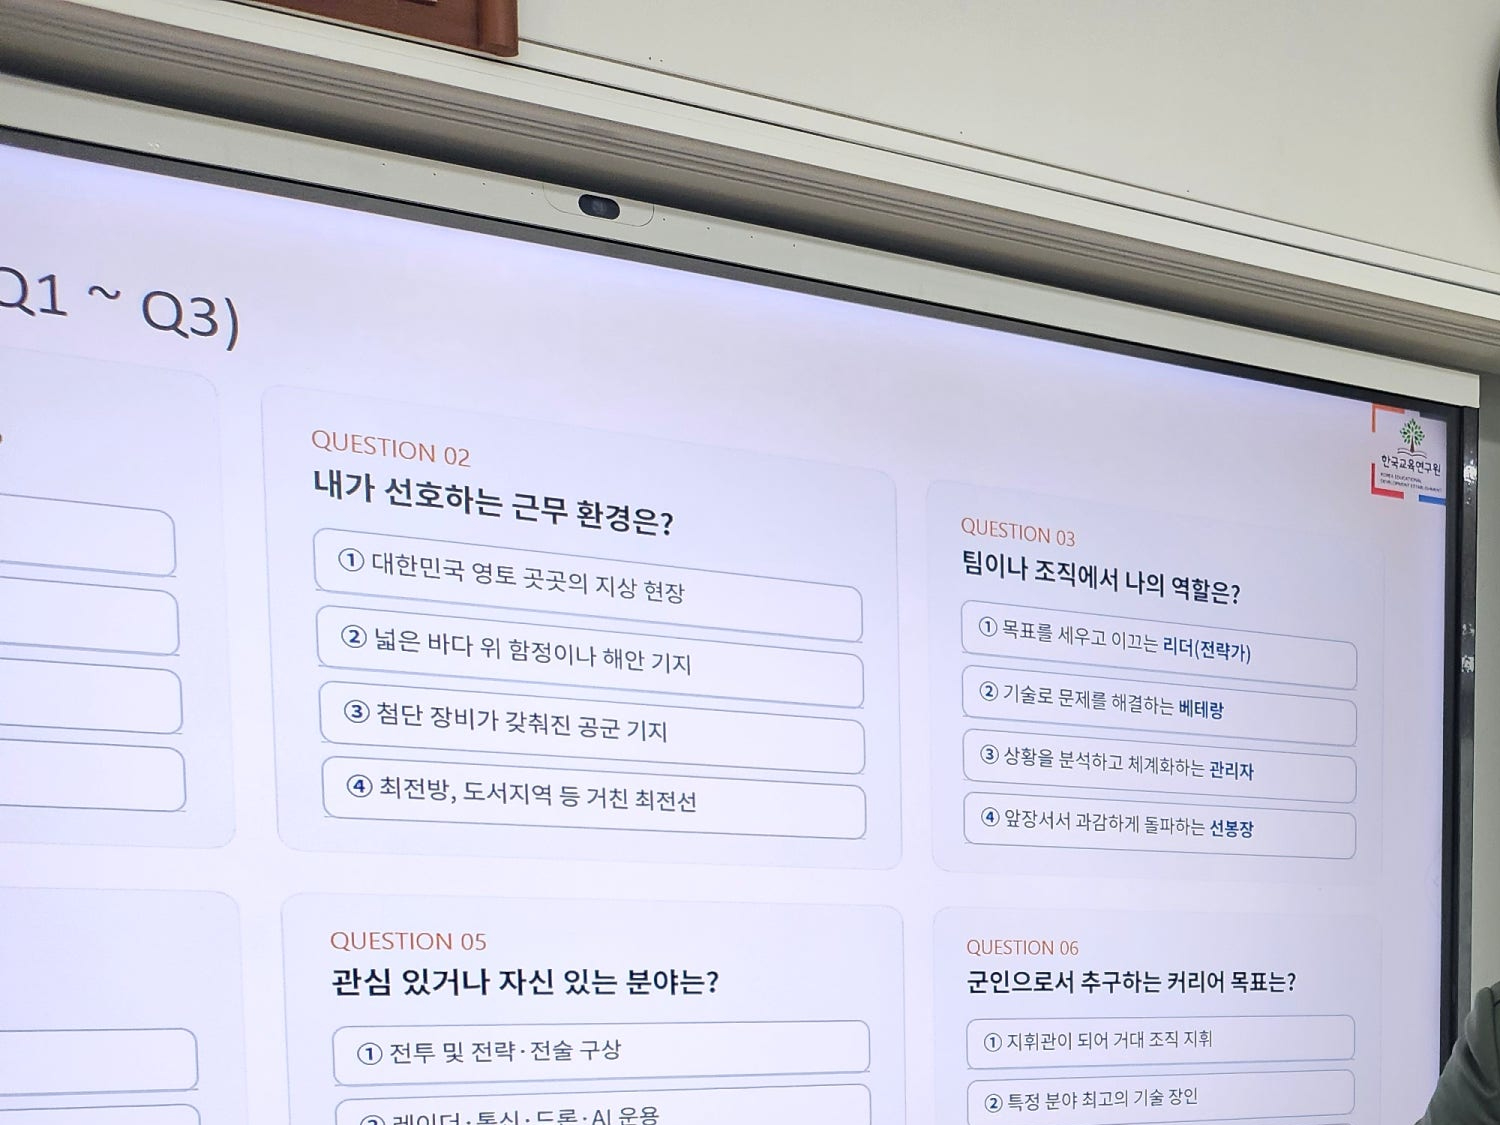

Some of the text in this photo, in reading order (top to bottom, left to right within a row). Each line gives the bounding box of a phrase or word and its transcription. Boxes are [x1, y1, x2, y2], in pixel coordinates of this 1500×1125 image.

[142, 290, 239, 351] Q3)
[311, 429, 472, 468] QUESTION 02
[1381, 454, 1441, 477] 한국교육연구원
[313, 469, 674, 537] 내가 선호하는 근무 환경은?
[960, 517, 1076, 548] QUESTION 03
[372, 552, 465, 583] 대한민국
[471, 562, 517, 586] 영토
[522, 567, 588, 596] 곳곳의
[595, 575, 638, 600] 지상
[643, 579, 686, 605] 현장
[963, 549, 1241, 605] 팀이나 조직에서 나의 역할은?
[375, 627, 421, 654] 넓은
[428, 632, 474, 658] 바다
[479, 637, 501, 660] 위
[508, 638, 597, 668] 함정이나
[602, 647, 646, 672] 해안
[651, 652, 691, 677] 기지
[1002, 619, 1053, 643] 목표를
[1057, 625, 1107, 647] 세우고
[1111, 631, 1159, 654] 이끄는
[1163, 636, 1251, 665] 리더(전략가)
[1003, 683, 1054, 705] 기술로
[1057, 688, 1107, 711] 문제를
[1111, 693, 1175, 716] 해결하는
[1178, 698, 1225, 720] 베테랑
[376, 701, 424, 727] 첨단
[430, 705, 500, 732] 장비가
[505, 710, 571, 737] 갖춰진
[577, 716, 621, 740] 공군
[627, 719, 667, 744] 기지
[1003, 746, 1054, 768] 상황을
[1058, 750, 1124, 772] 분석하고
[1127, 755, 1206, 778] 체계화하는
[1209, 760, 1255, 782] 관리자
[379, 775, 457, 805] 최전방,
[462, 781, 552, 807] 도서지역
[559, 785, 581, 808] 등
[586, 786, 629, 810] 거친
[635, 788, 697, 813] 최전선
[1004, 808, 1071, 831] 앞장서서
[1075, 812, 1140, 834] 과감하게
[1144, 816, 1206, 837] 돌파하는
[1209, 819, 1255, 839] 선봉장
[330, 931, 487, 952] QUESTION 05
[966, 938, 1079, 957] QUESTION 06
[331, 967, 719, 997] 관심 있거나 자신 있는 분야는?
[966, 969, 1297, 995] 군인으로서 추구하는 커리어 목표는?
[389, 1042, 437, 1065] 전투
[442, 1041, 464, 1064] 및
[579, 1038, 622, 1061] 구상
[1006, 1031, 1072, 1052] 지휘관이
[1077, 1031, 1109, 1051] 되어
[1113, 1030, 1144, 1050] 거대
[1148, 1029, 1179, 1049] 조직
[1183, 1029, 1212, 1049] 지휘
[1007, 1092, 1040, 1113] 특정
[1044, 1091, 1078, 1111] 분야
[1081, 1089, 1128, 1110] 최고의
[1133, 1088, 1165, 1107] 기술
[1168, 1087, 1198, 1106] 장인
